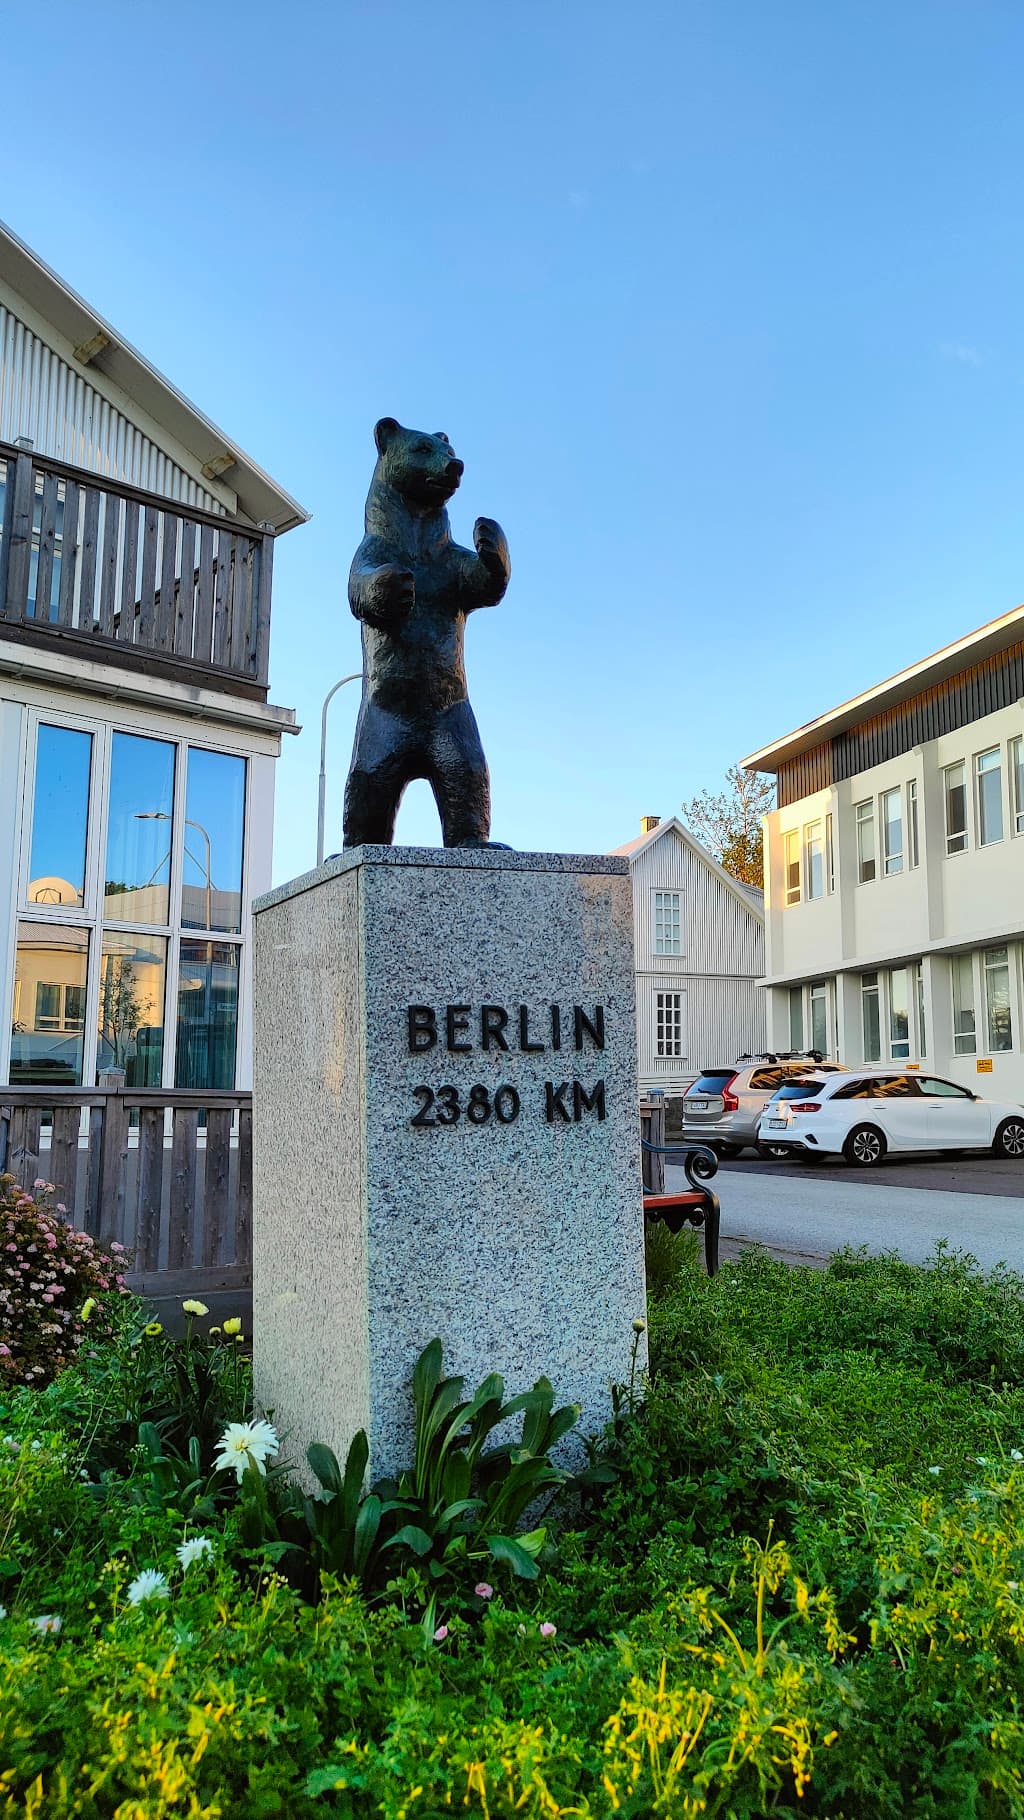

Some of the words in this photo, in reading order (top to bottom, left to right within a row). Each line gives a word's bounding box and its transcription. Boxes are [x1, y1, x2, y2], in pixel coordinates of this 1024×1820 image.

[408, 1004, 605, 1051] BERLIN
[411, 1083, 521, 1126] 2380
[544, 1080, 606, 1123] KM
